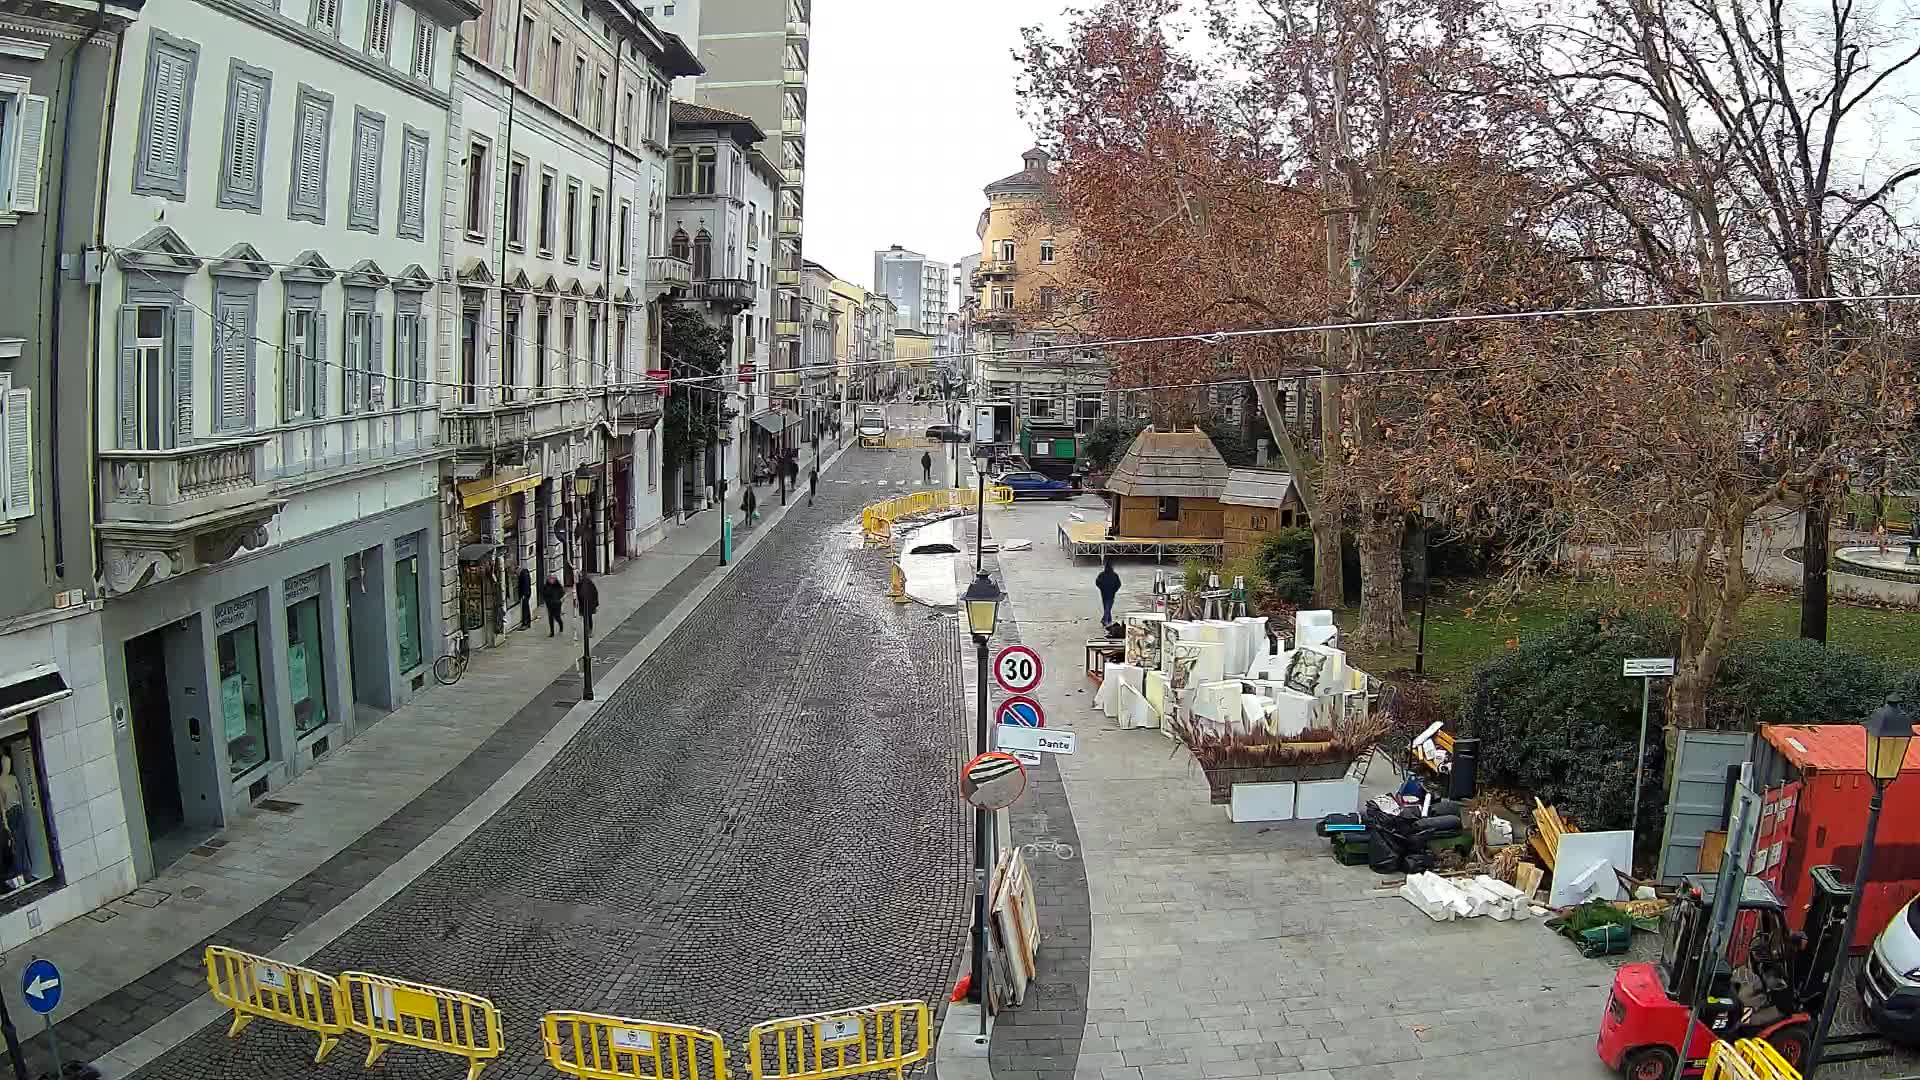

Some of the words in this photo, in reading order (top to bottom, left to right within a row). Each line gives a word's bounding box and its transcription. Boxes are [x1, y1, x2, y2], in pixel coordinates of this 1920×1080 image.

[1005, 658, 1032, 680] 30
[1039, 738, 1070, 749] Dante
[1712, 1019, 1728, 1029] 25
